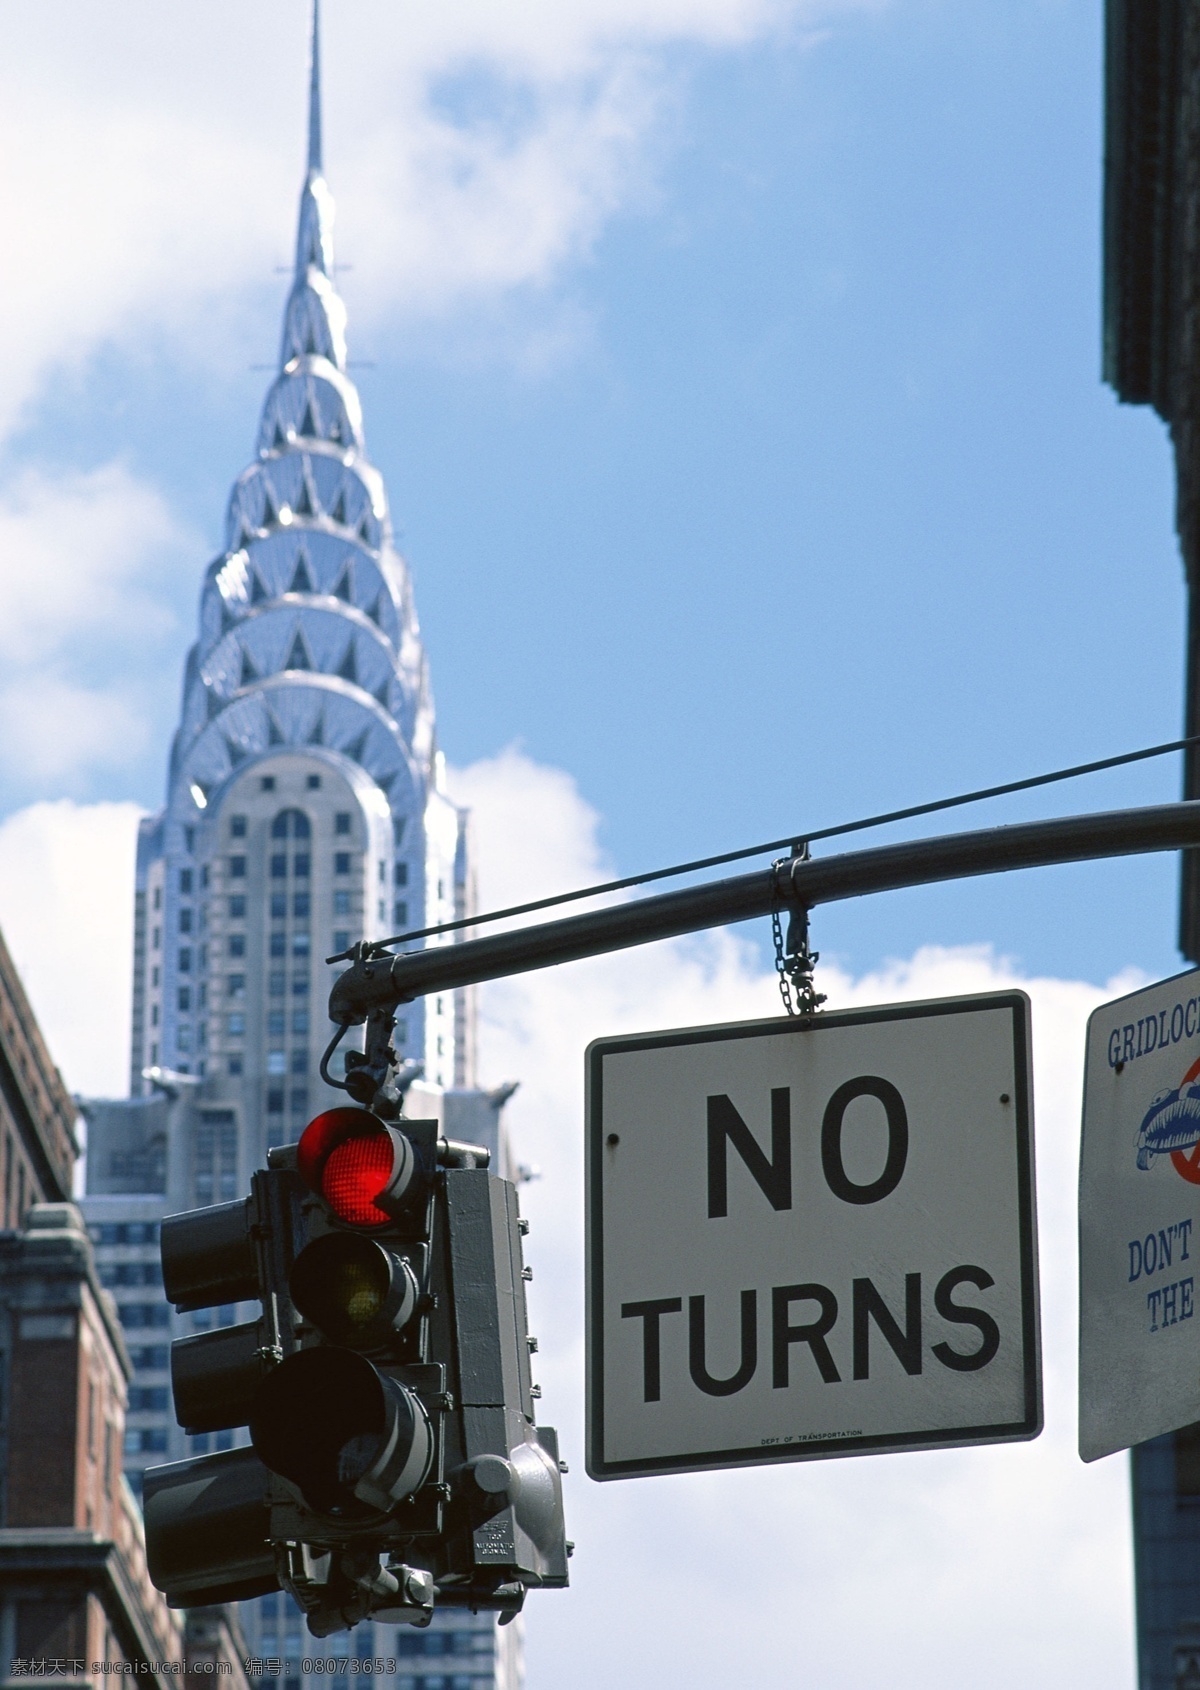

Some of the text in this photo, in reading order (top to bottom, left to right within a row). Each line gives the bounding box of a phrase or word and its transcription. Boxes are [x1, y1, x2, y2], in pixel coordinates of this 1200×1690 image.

[1108, 996, 1200, 1068] GRIDLOC
[706, 1075, 909, 1219] NO
[1128, 1218, 1192, 1283] DON'T
[621, 1264, 1001, 1403] TURNS
[1147, 1277, 1194, 1333] THE
[798, 1430, 863, 1441] TRANSPORTATION
